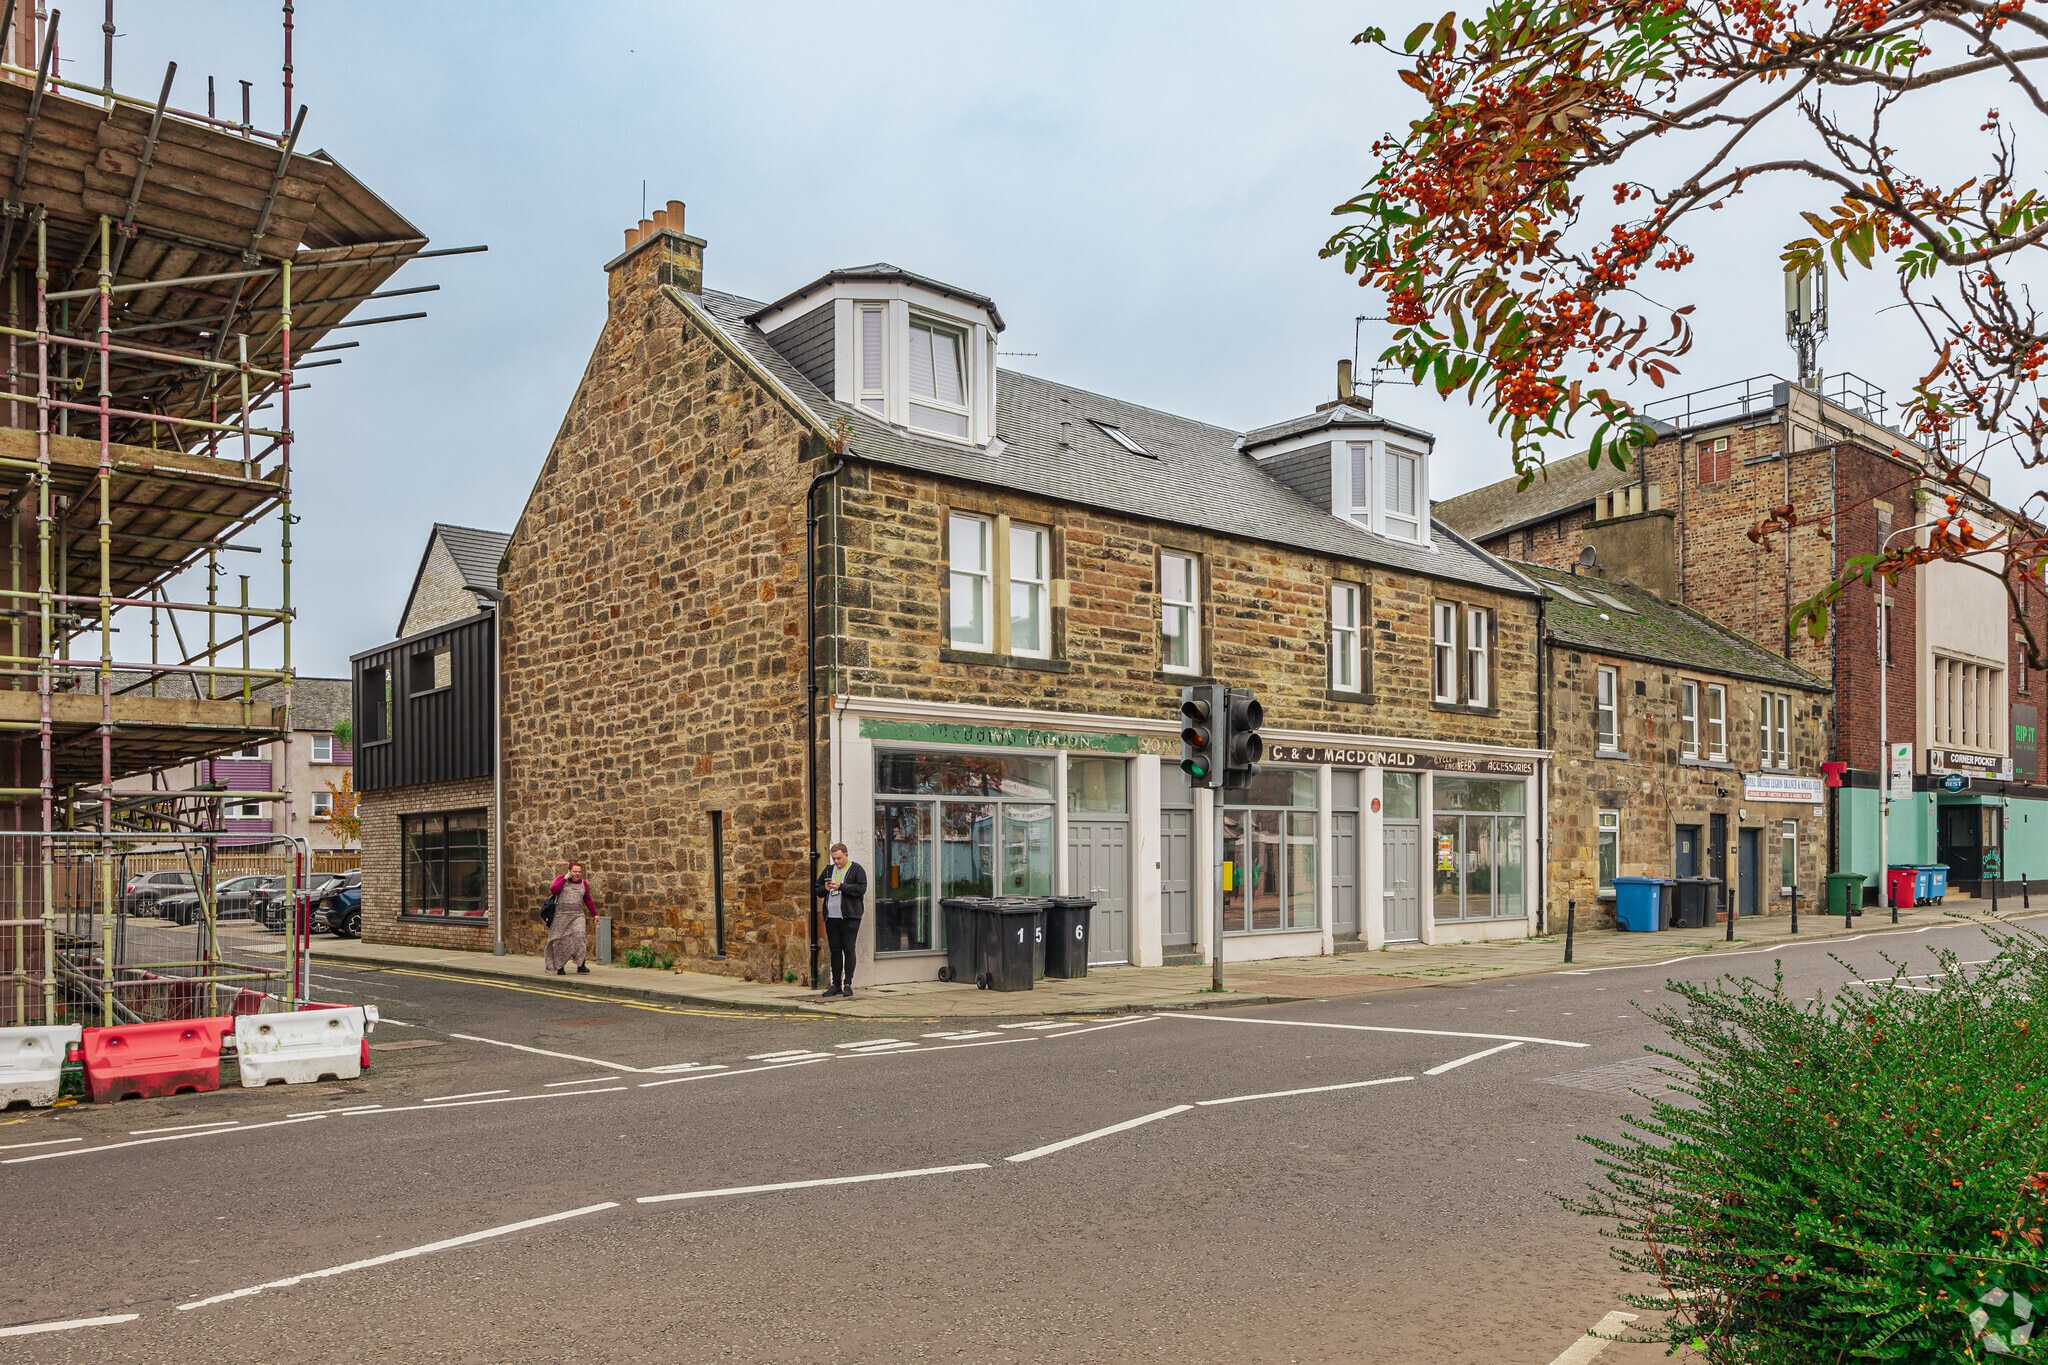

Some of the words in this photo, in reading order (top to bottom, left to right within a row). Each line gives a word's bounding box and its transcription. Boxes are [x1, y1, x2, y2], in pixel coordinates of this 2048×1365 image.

[2015, 724, 2027, 742] RIP
[1291, 748, 1300, 760] &
[1324, 749, 1416, 767] MACDONALD
[1950, 753, 1974, 765] CORNER
[1974, 756, 1997, 767] POCKET
[1487, 761, 1532, 773] ACCESSORIES
[1017, 927, 1024, 943] 1
[1035, 926, 1042, 943] 5
[1075, 924, 1083, 940] 6
